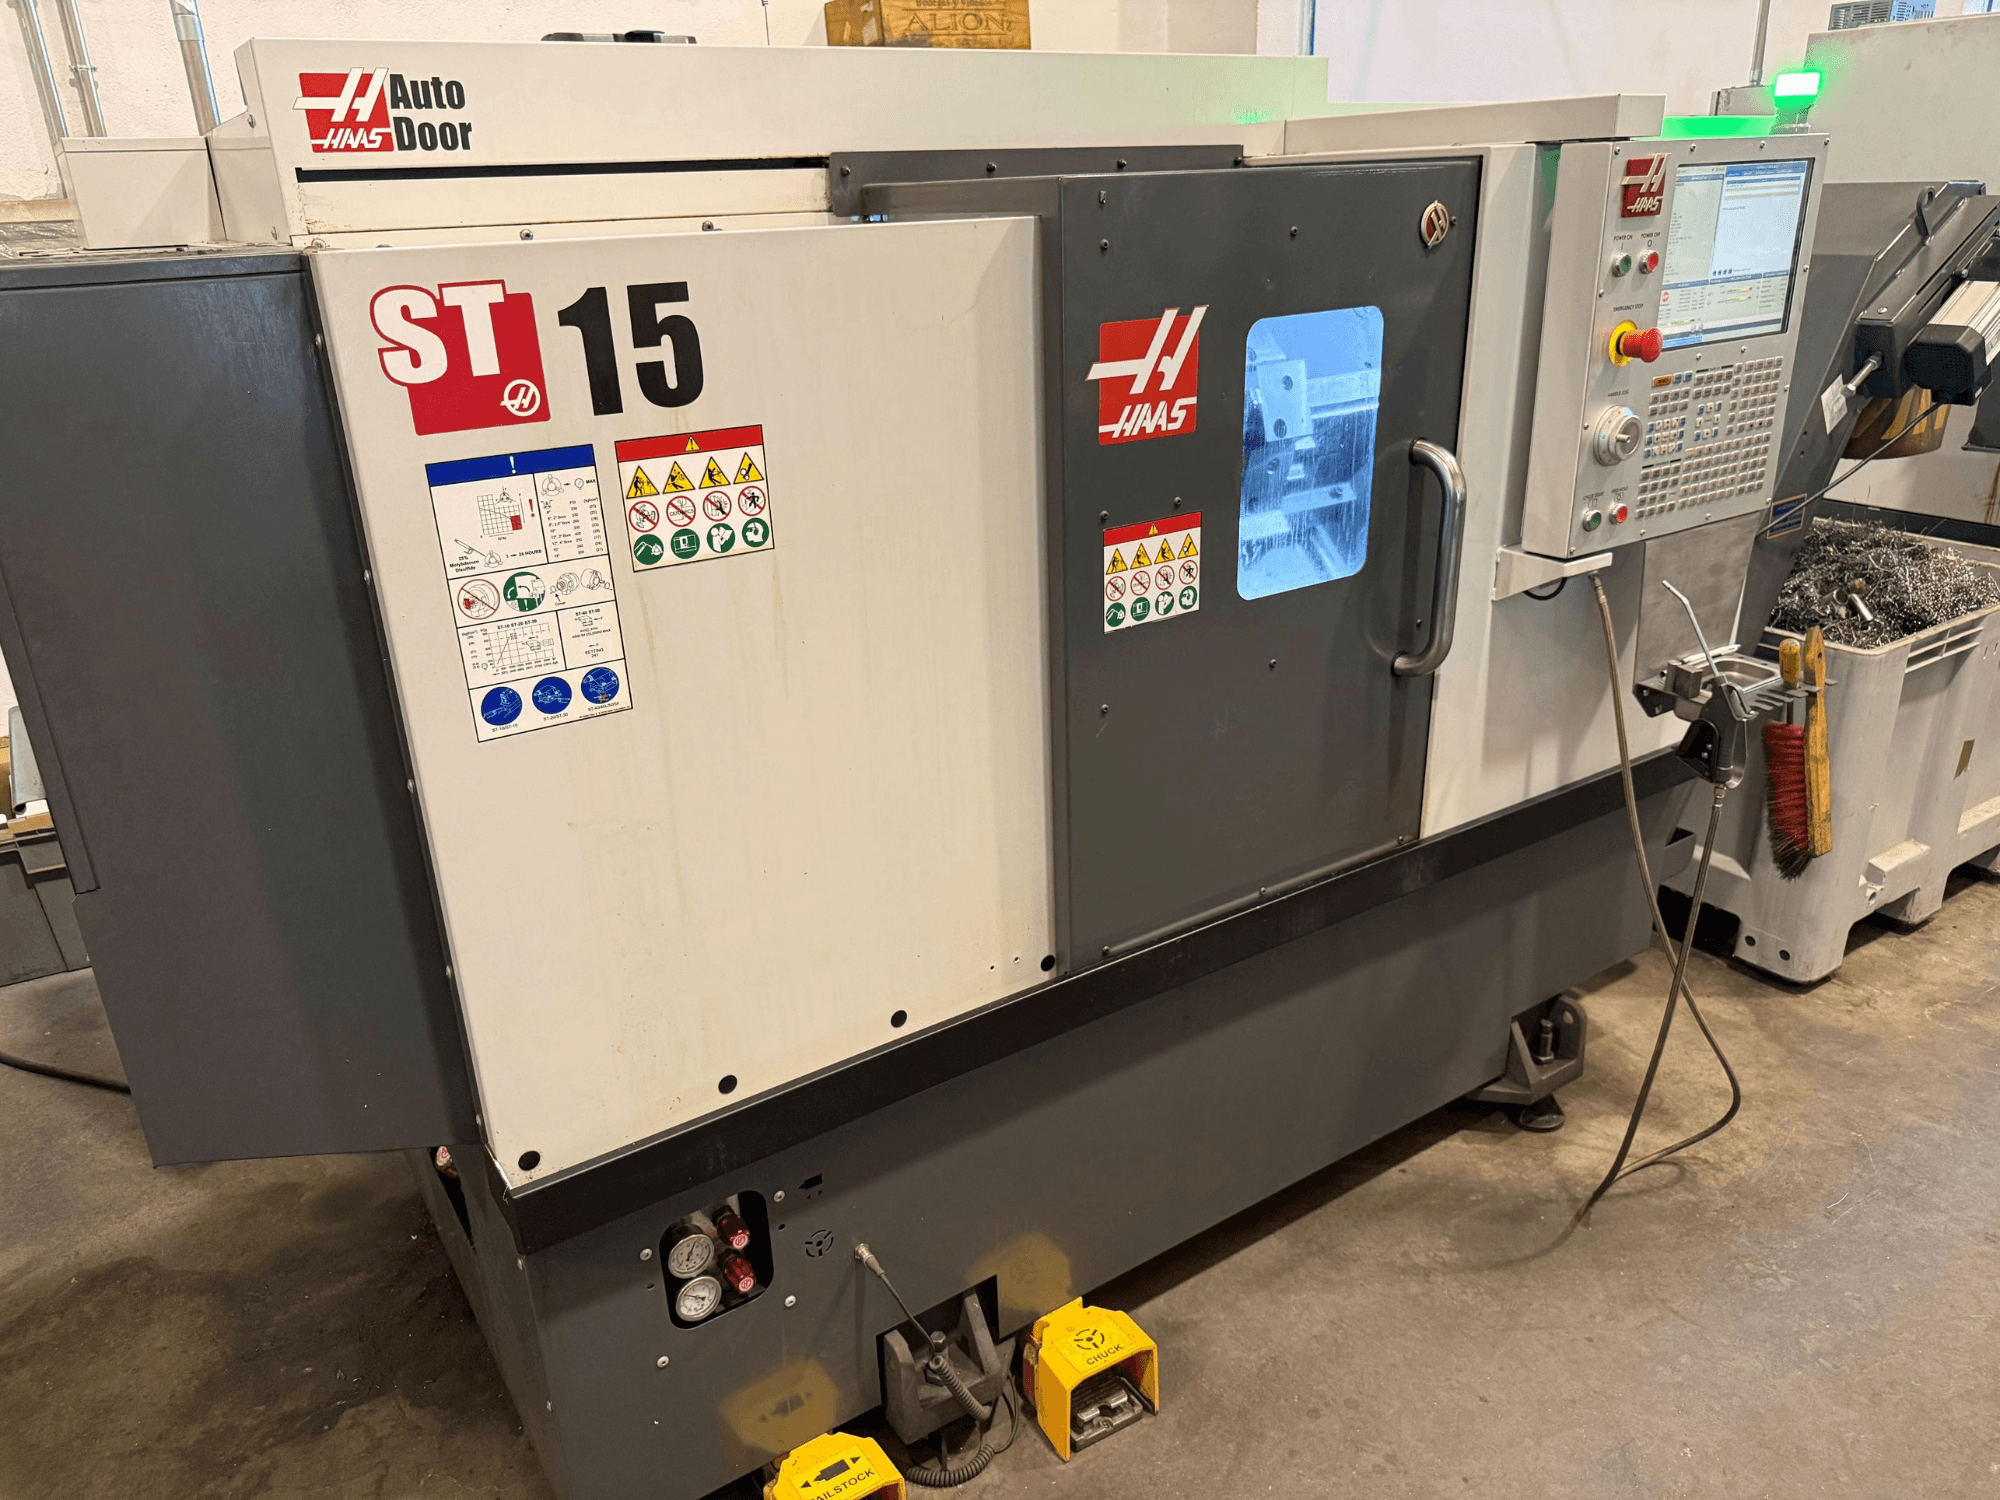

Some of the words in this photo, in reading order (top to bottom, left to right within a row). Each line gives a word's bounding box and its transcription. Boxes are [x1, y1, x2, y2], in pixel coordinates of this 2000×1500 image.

[389, 73, 466, 110] Auto
[311, 127, 392, 149] HAAS
[392, 116, 472, 151] Door
[1627, 196, 1664, 213] HAAS
[1626, 233, 1634, 241] ON
[369, 279, 507, 387] ST
[557, 281, 704, 416] 15
[1099, 396, 1197, 438] HAAS
[449, 560, 480, 568] Molybdenum
[1086, 1343, 1124, 1365] CHUCK
[811, 1468, 875, 1500] AILSTOCK
